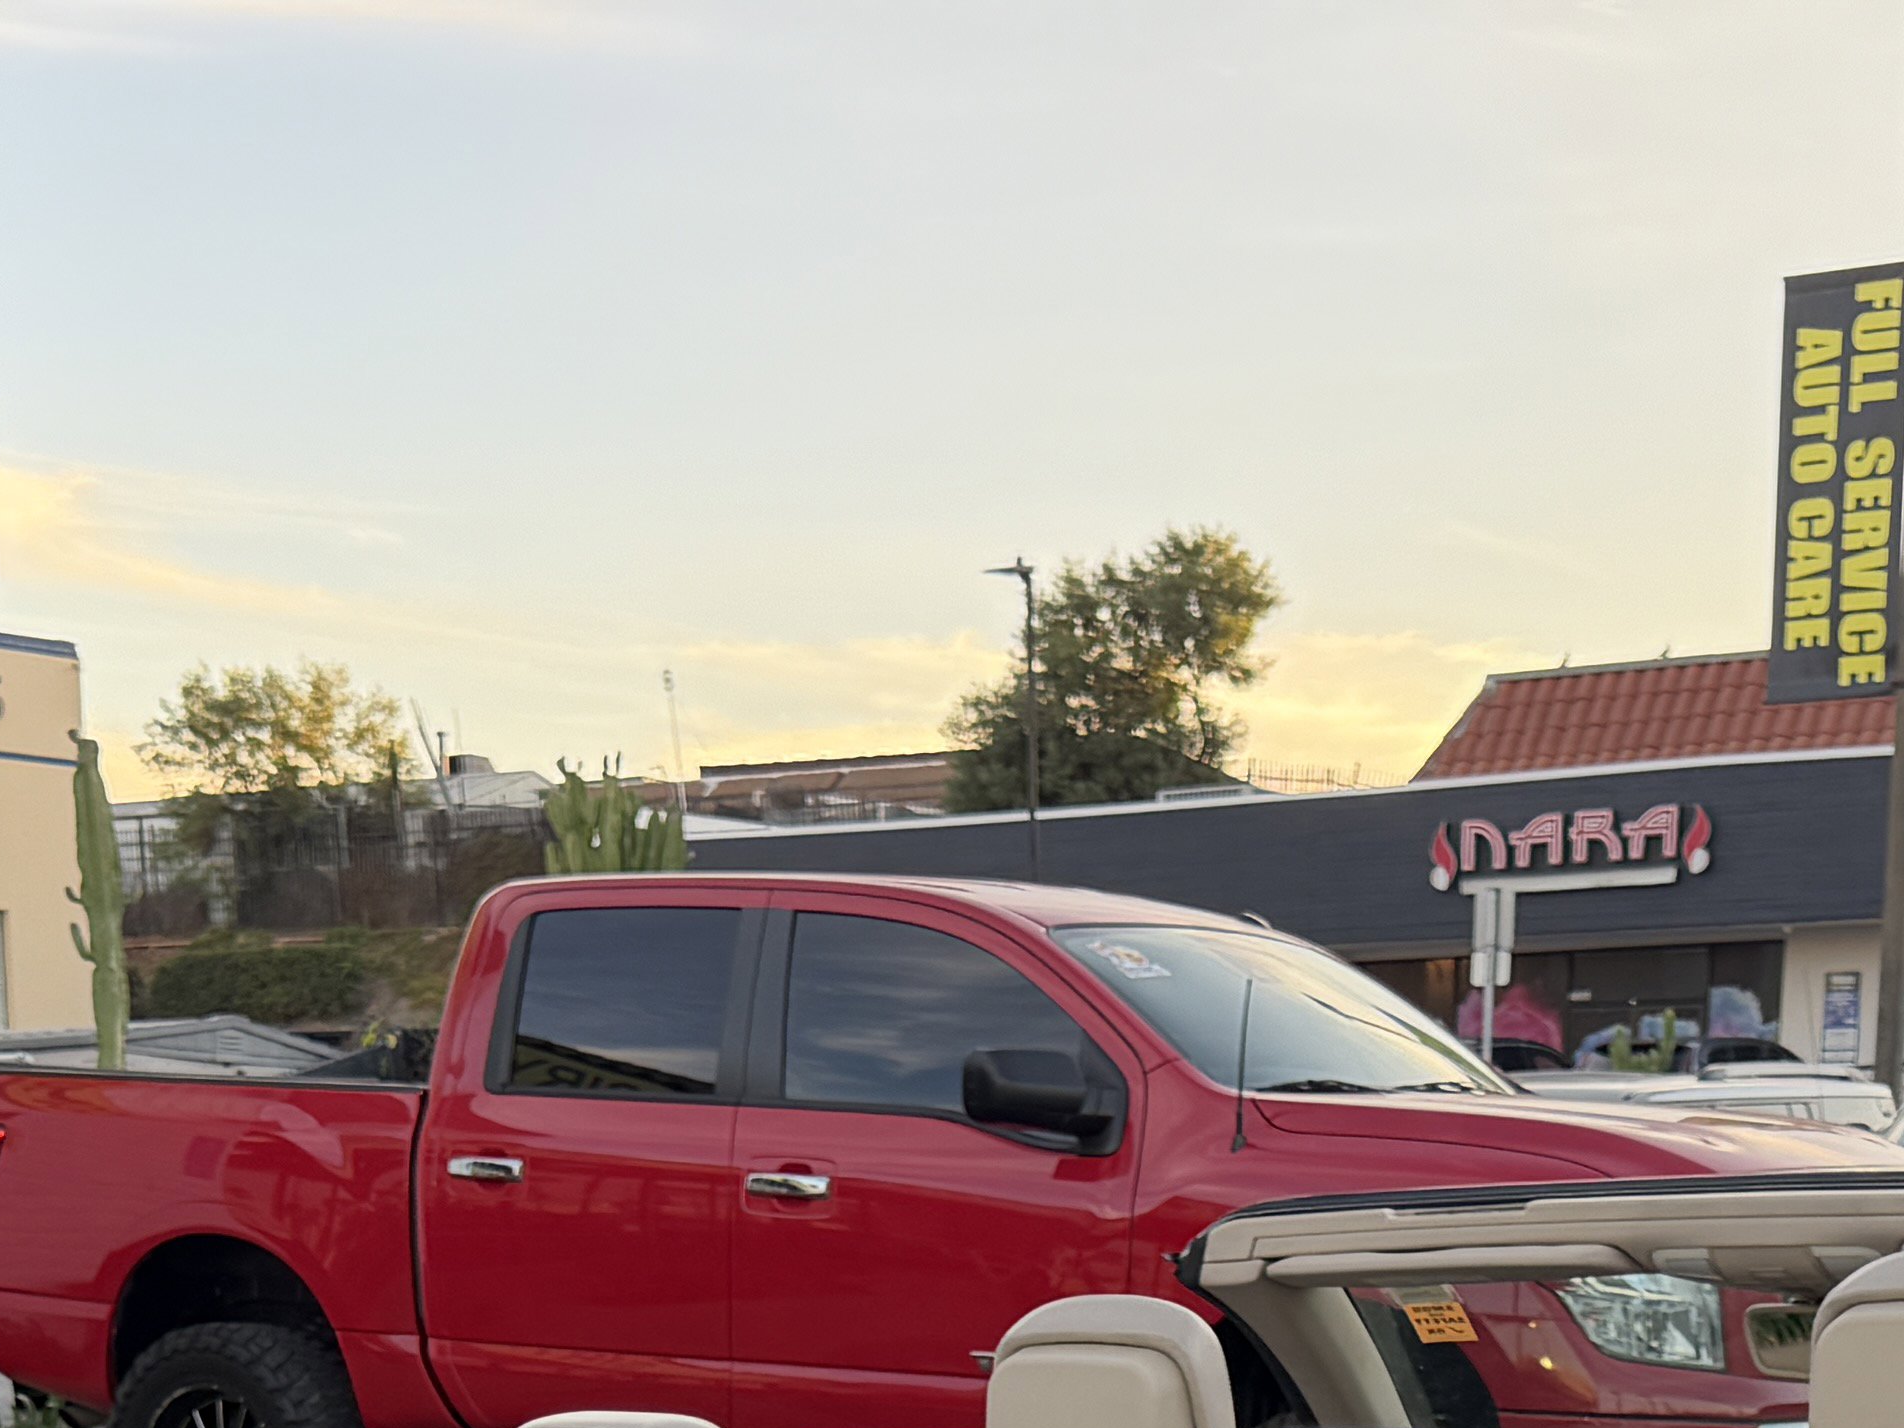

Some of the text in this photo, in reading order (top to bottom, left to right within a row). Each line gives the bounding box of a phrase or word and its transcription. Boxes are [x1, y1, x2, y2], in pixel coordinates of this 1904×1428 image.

[1783, 327, 1843, 651] AUTO CARE
[1838, 277, 1903, 687] FULL SERVICE
[1459, 803, 1680, 872] NARA
